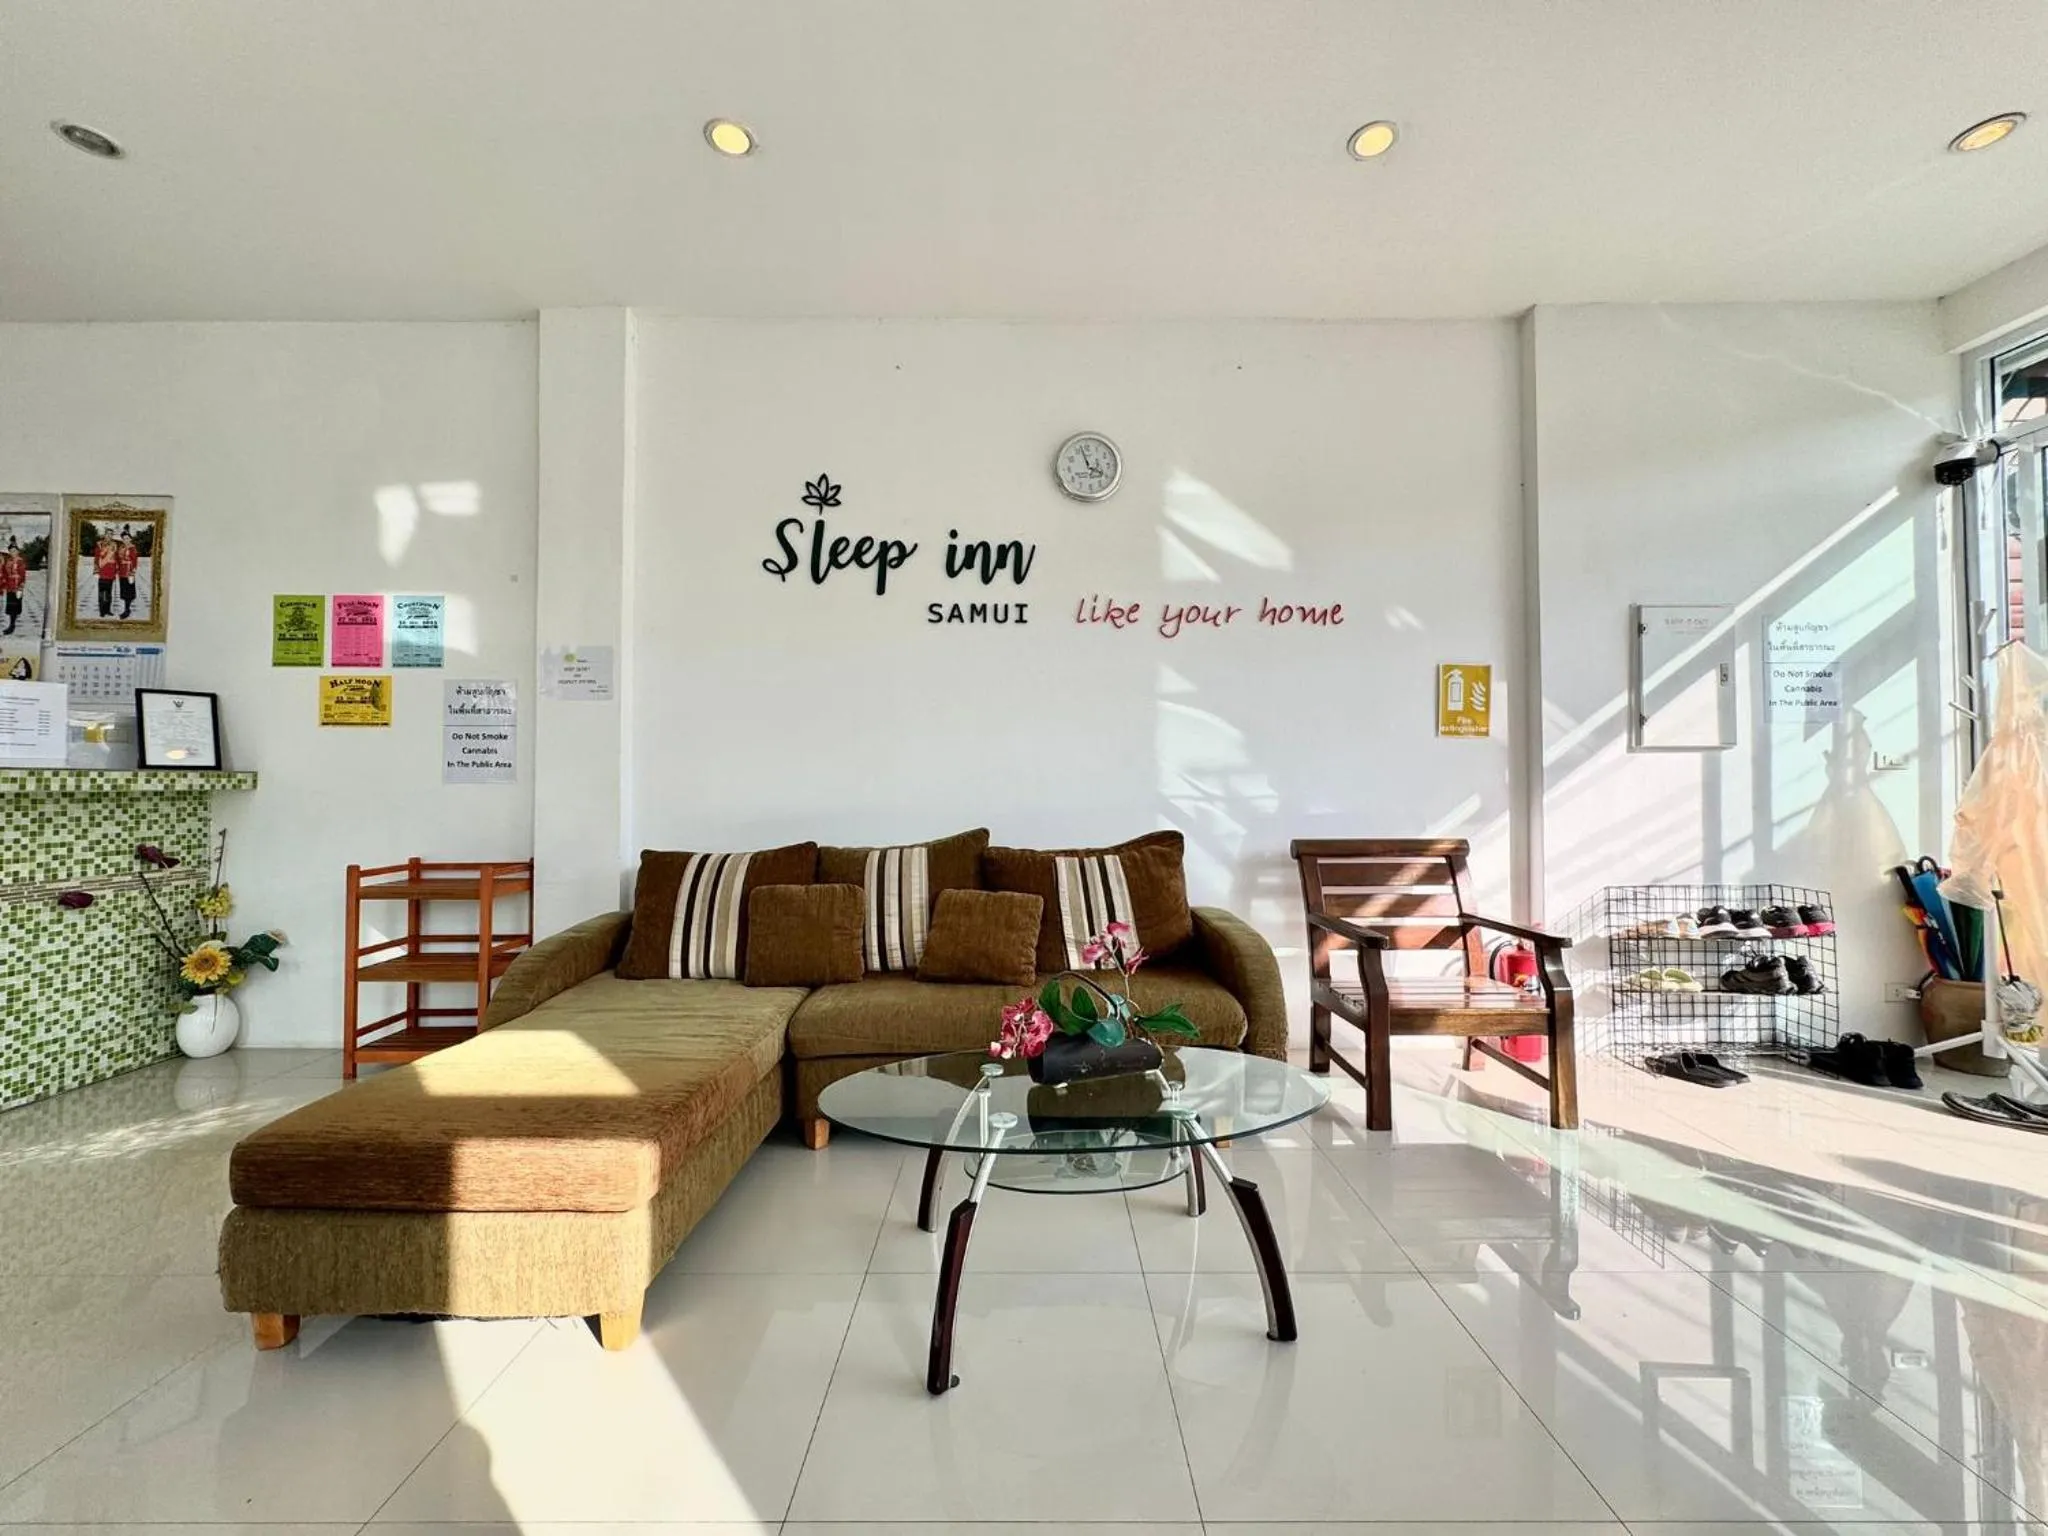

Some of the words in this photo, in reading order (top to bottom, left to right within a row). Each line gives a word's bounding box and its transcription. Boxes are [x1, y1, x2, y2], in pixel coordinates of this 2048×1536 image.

[762, 518, 918, 595] Sleep
[945, 529, 1036, 585] inn
[928, 603, 1029, 624] SAMUI
[1076, 594, 1140, 629] like
[1158, 602, 1242, 638] your
[1257, 596, 1345, 626] home
[1773, 670, 1785, 678] Do
[1787, 670, 1803, 678] Not
[1805, 669, 1833, 678] Smoke
[1784, 684, 1823, 693] Cannabis
[1768, 699, 1777, 707] In
[1779, 699, 1793, 707] The
[1795, 699, 1818, 707] Public
[1819, 699, 1838, 707] Area
[452, 732, 464, 740] Do
[465, 732, 480, 740] Not
[481, 732, 508, 740] Smoke
[462, 747, 498, 755] Cannabis
[471, 760, 493, 768] Public
